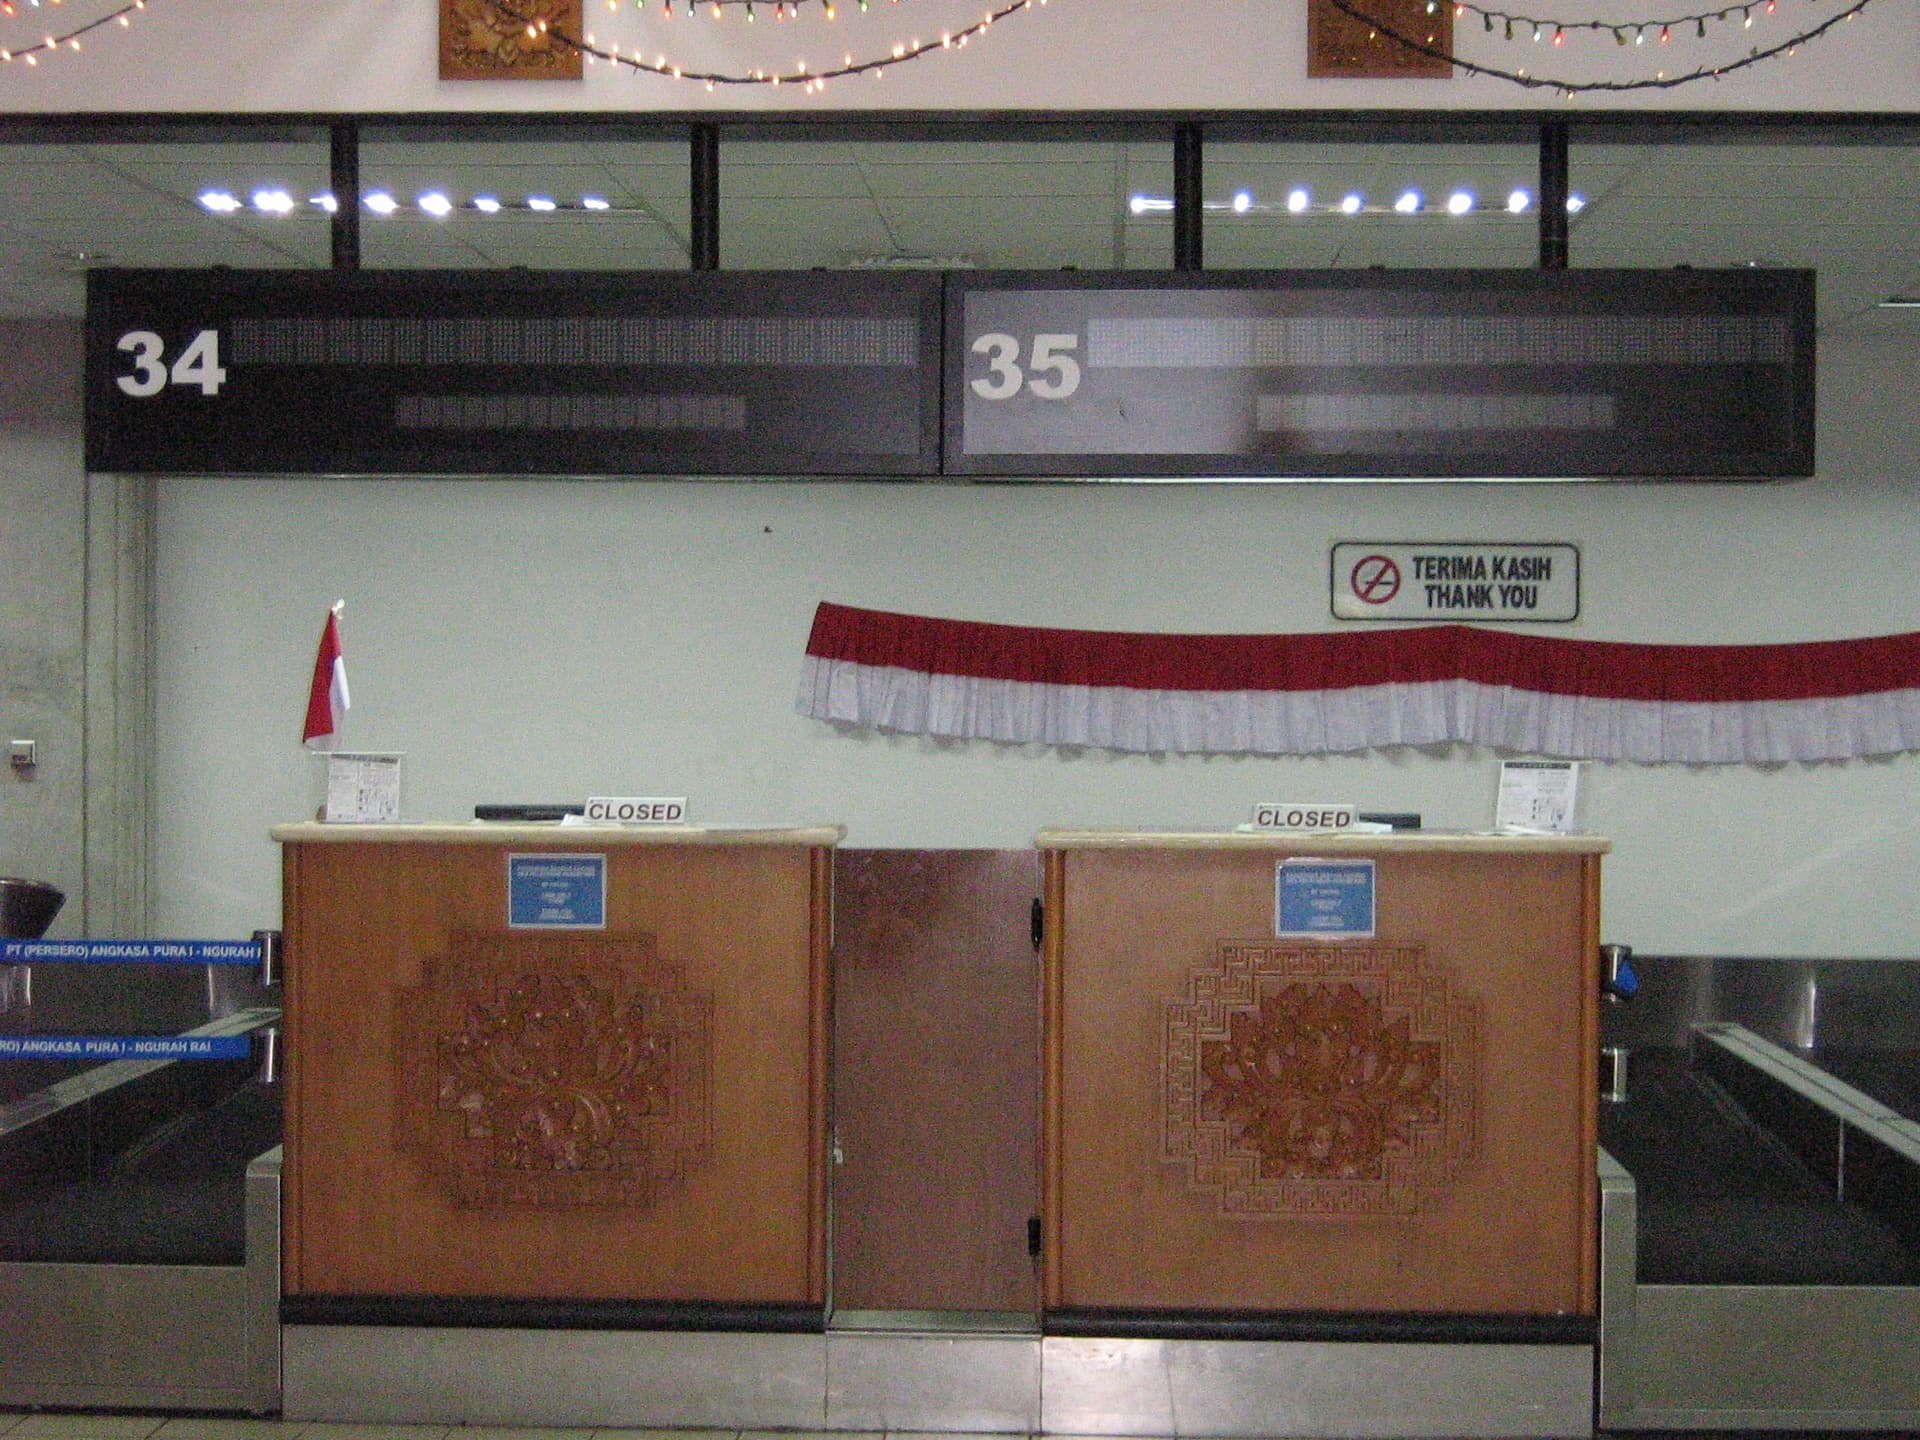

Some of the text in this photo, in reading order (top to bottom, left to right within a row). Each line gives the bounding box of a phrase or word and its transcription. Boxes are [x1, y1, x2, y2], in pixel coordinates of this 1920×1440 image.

[116, 330, 227, 397] 34
[970, 332, 1081, 400] 35
[1412, 555, 1552, 581] TERIMA KASIH
[1424, 584, 1538, 609] THANK YOU
[588, 803, 682, 821] CLOSED
[1257, 809, 1351, 828] CLOSED
[6, 944, 22, 956] PT
[24, 944, 89, 959] (PERSERO)
[91, 945, 150, 957] ANGKASA
[153, 945, 188, 957] PURA
[202, 945, 254, 957] NGURAH
[22, 1040, 82, 1053] ANGKASA
[86, 1040, 120, 1053] PURA
[135, 1041, 187, 1052] NGURAH
[190, 1041, 212, 1052] RAI
